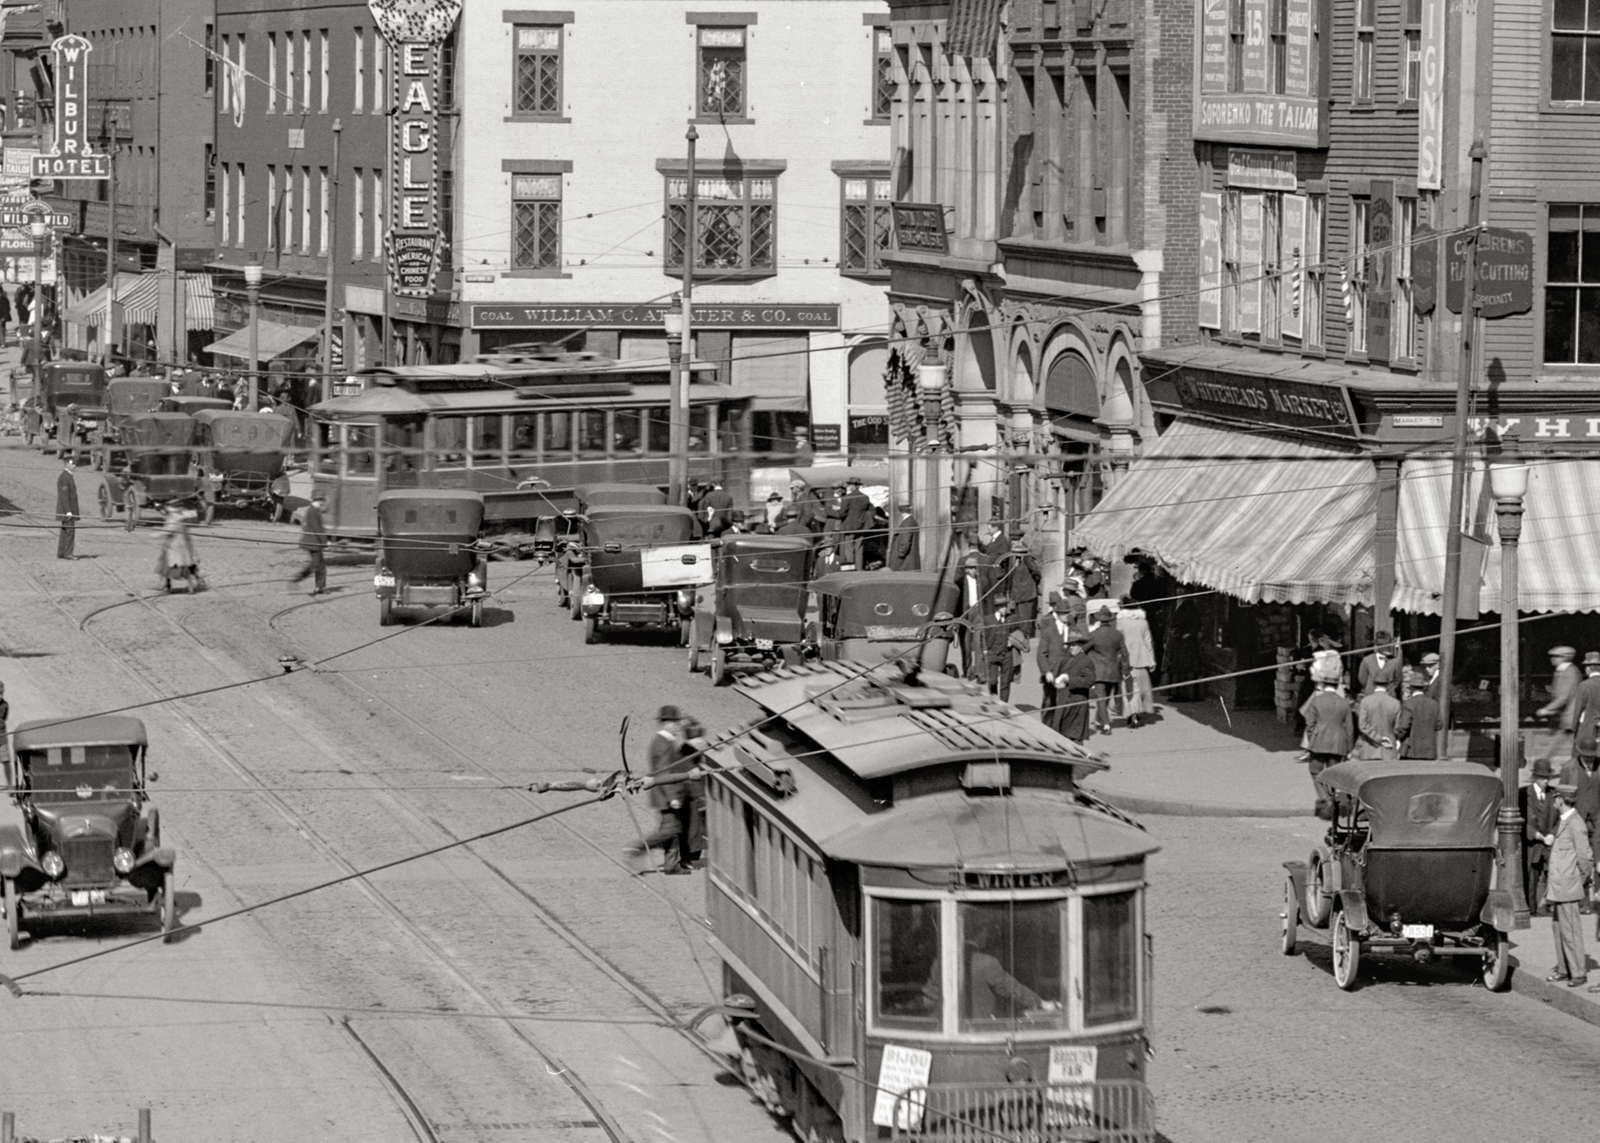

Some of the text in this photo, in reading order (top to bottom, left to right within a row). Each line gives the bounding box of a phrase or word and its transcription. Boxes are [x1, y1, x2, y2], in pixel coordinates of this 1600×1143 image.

[64, 48, 79, 154] WILBUR
[1255, 102, 1275, 126] THE
[1278, 102, 1318, 130] TAILOR
[402, 43, 431, 229] EAGLE
[38, 159, 105, 174] HOTEL
[3, 213, 69, 225] WILD WILD
[396, 237, 435, 253] RESTAURANT
[398, 252, 432, 264] AMERICAN
[400, 267, 428, 275] CHINESE
[1480, 261, 1529, 281] CUTTING
[480, 311, 514, 321] COAL
[524, 309, 614, 322] WILLIAM
[621, 309, 639, 322] C.
[740, 309, 755, 322] &
[762, 309, 791, 322] CO.
[798, 311, 832, 321] COAL
[1268, 388, 1330, 421] MARKET
[851, 418, 867, 429] THE
[977, 873, 1054, 889] WINTER
[886, 1048, 929, 1069] BIJOU
